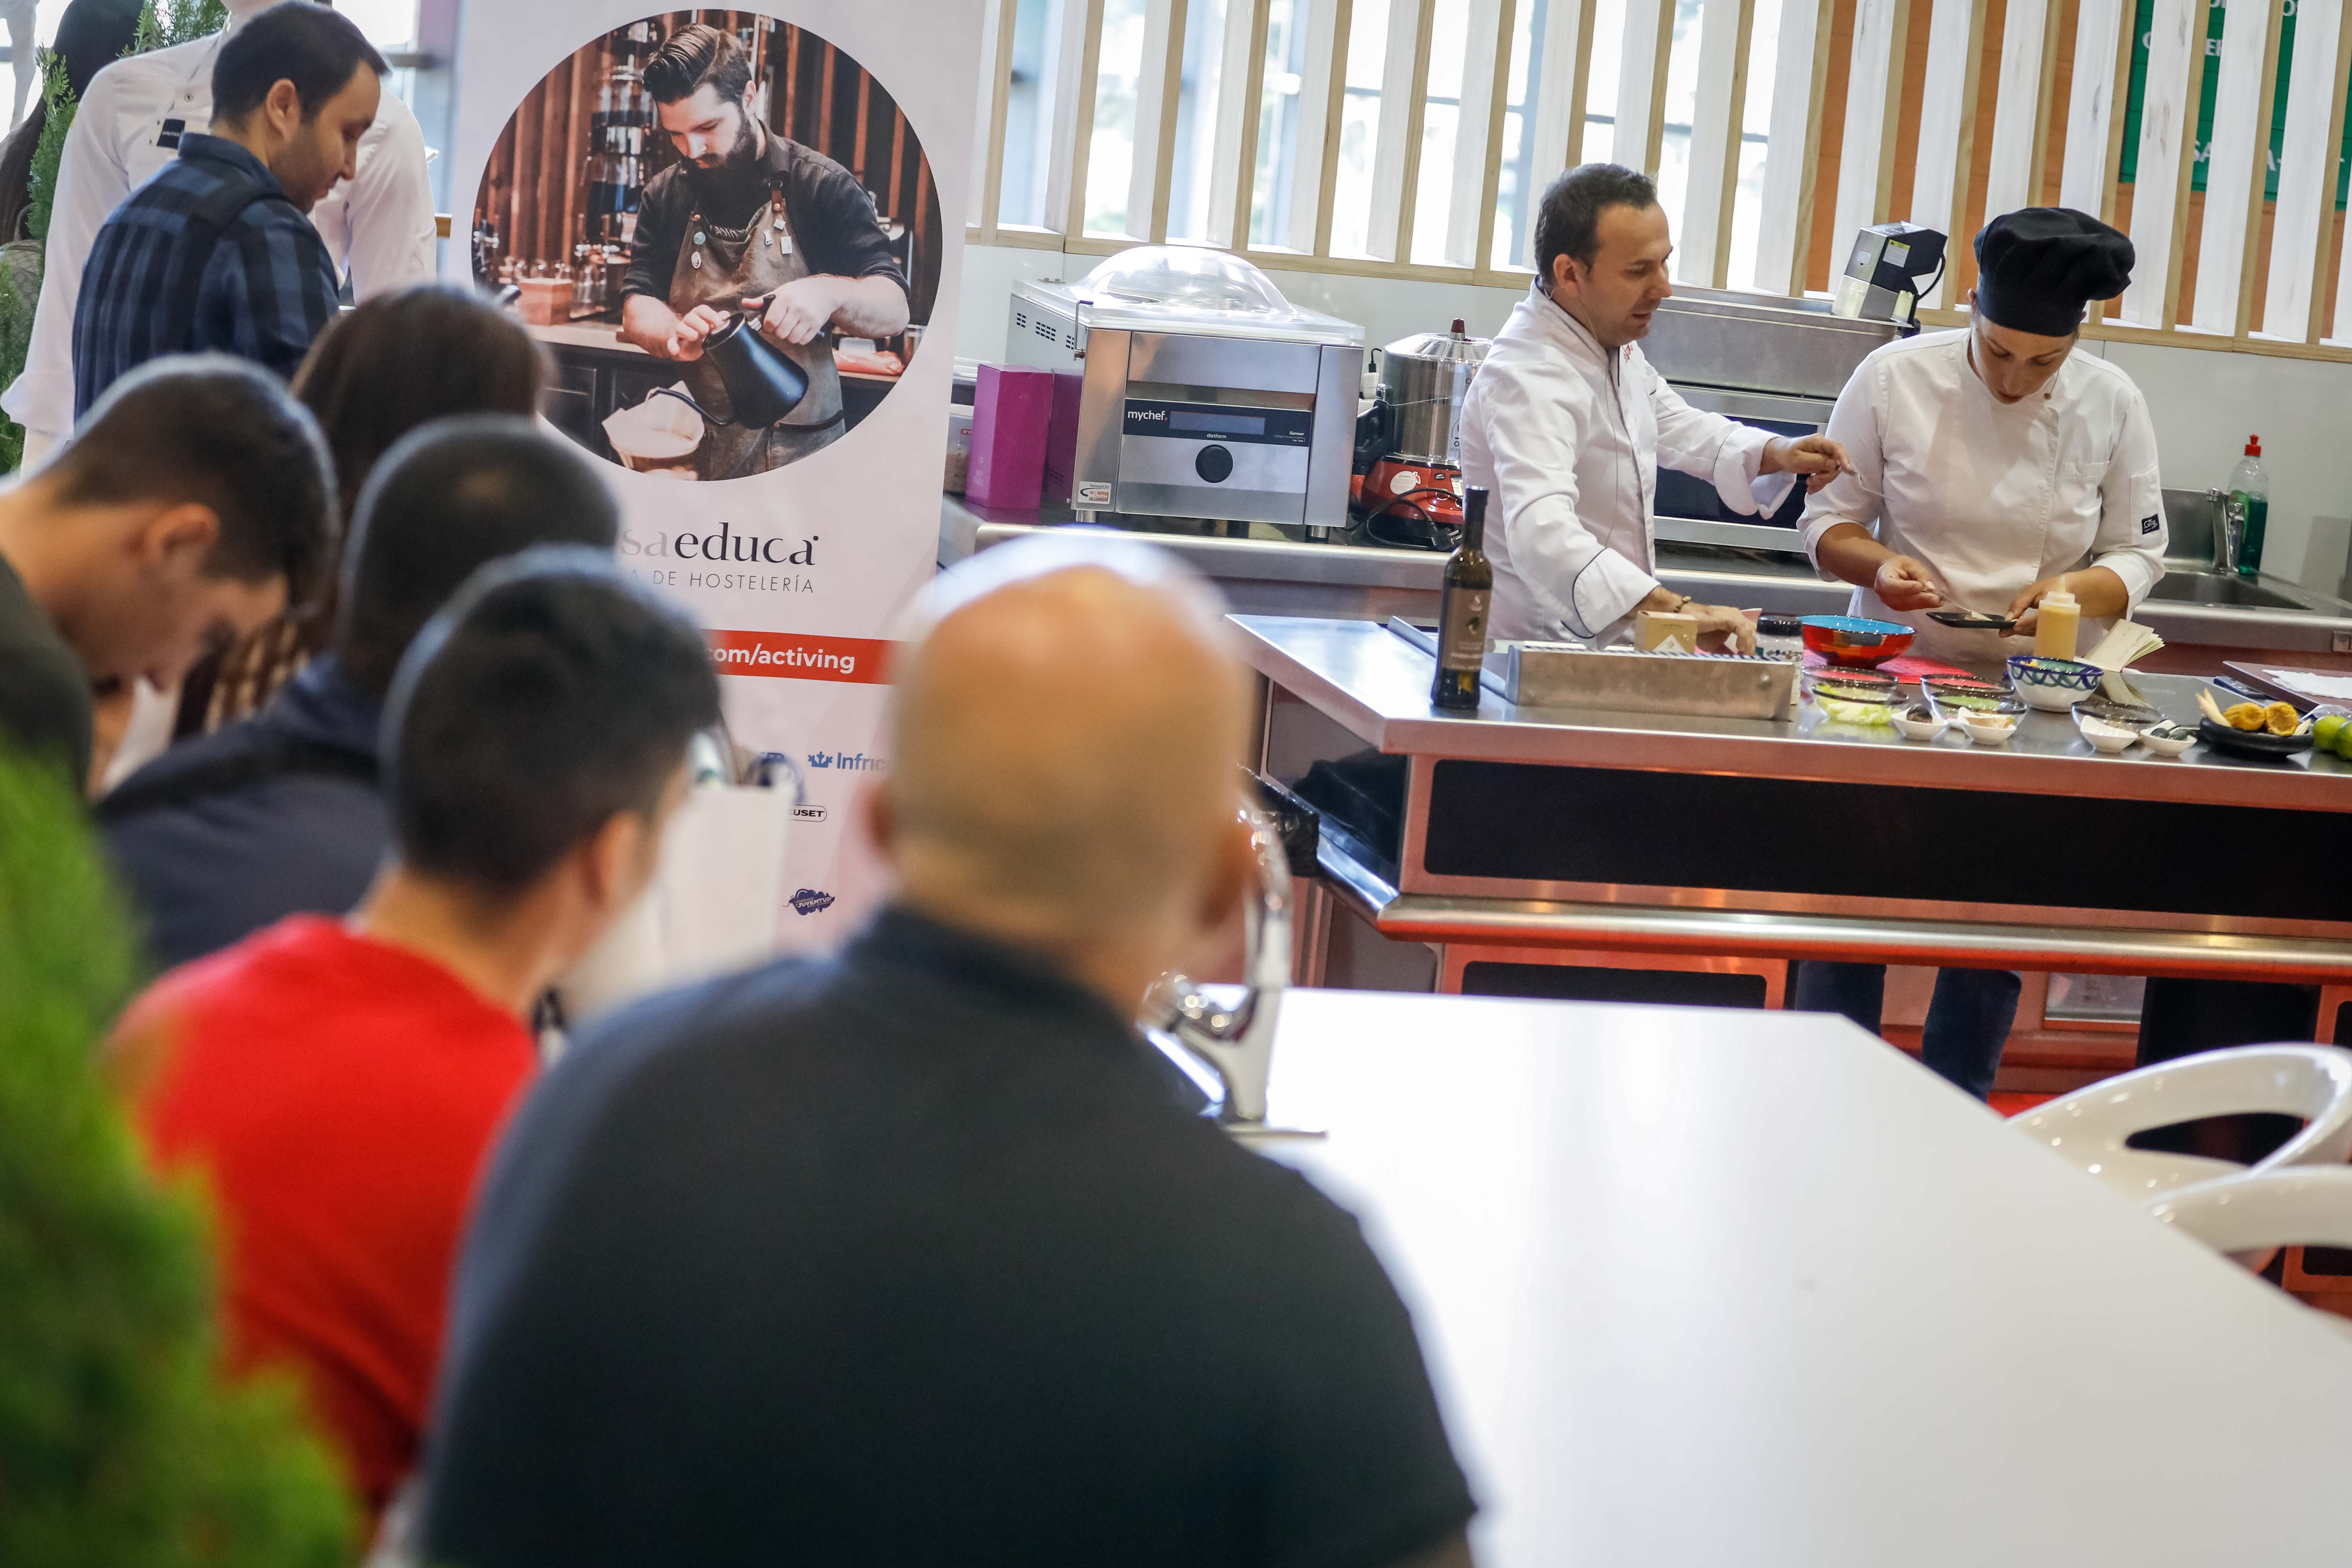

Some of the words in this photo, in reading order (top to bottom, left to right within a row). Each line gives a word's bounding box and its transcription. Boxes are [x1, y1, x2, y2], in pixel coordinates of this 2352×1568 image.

[653, 570, 676, 586] DE
[690, 573, 814, 593] HOSTELERÍA
[709, 643, 855, 674] om/activing
[797, 897, 832, 908] JUVENTUD
